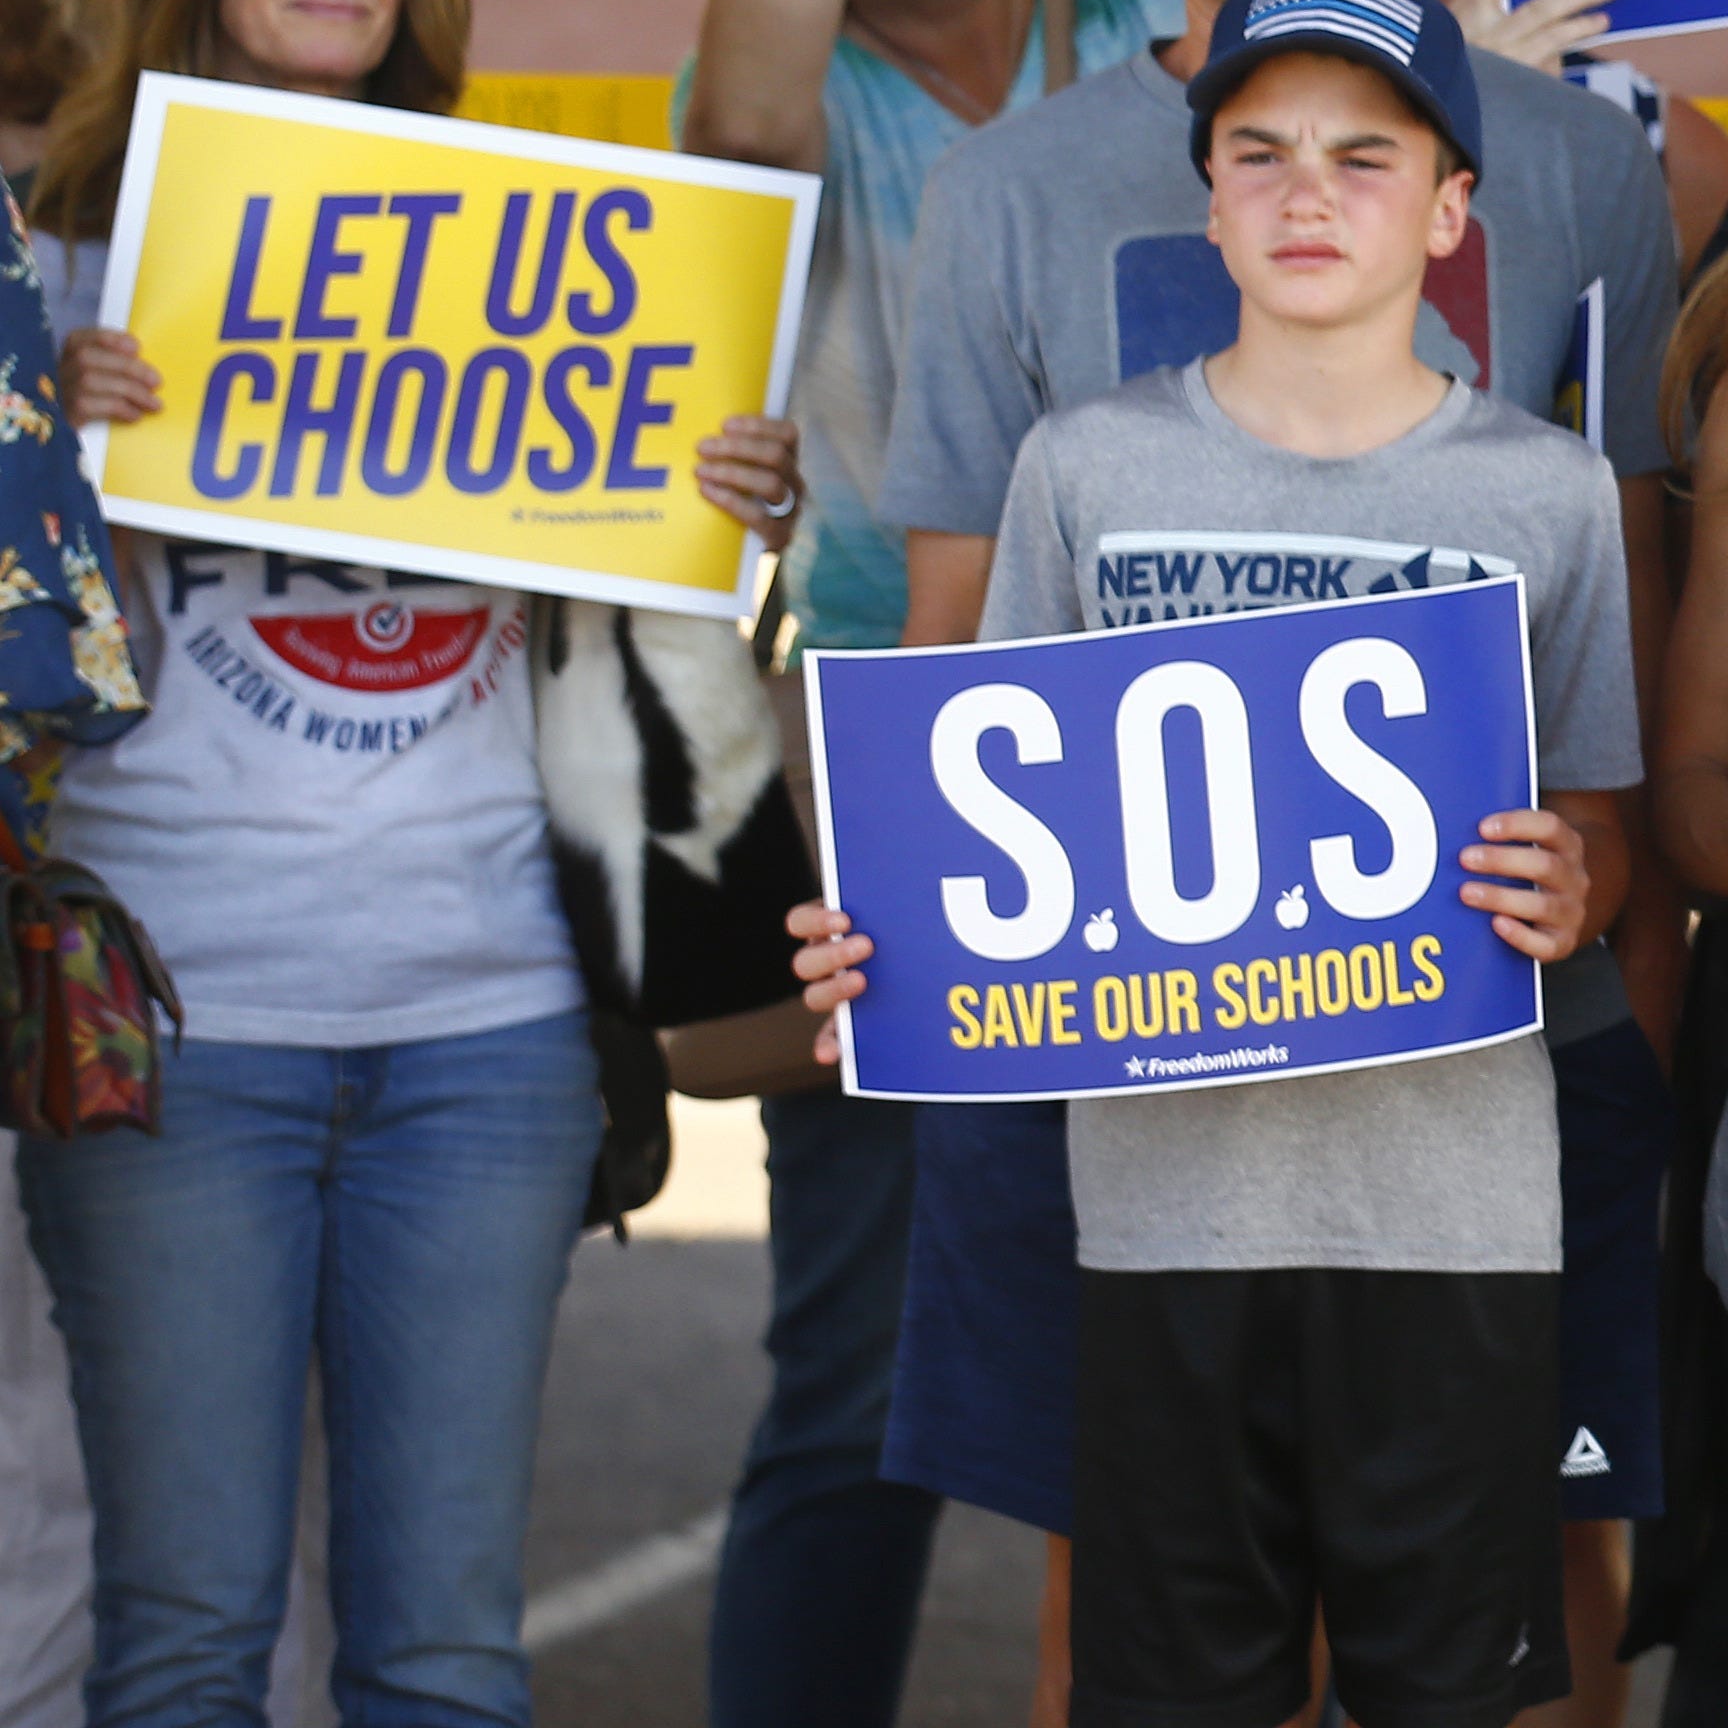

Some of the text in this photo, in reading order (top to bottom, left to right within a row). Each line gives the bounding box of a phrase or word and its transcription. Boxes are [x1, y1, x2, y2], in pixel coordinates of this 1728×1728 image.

[219, 186, 653, 342] LET US
[189, 343, 696, 500] CHOOSE
[1098, 552, 1354, 600] NEW YORK
[929, 636, 1440, 964] S.O.S
[946, 934, 1446, 1050] SAVE OUR SCHOOLS
[1147, 1043, 1290, 1078] FreedomWorks
